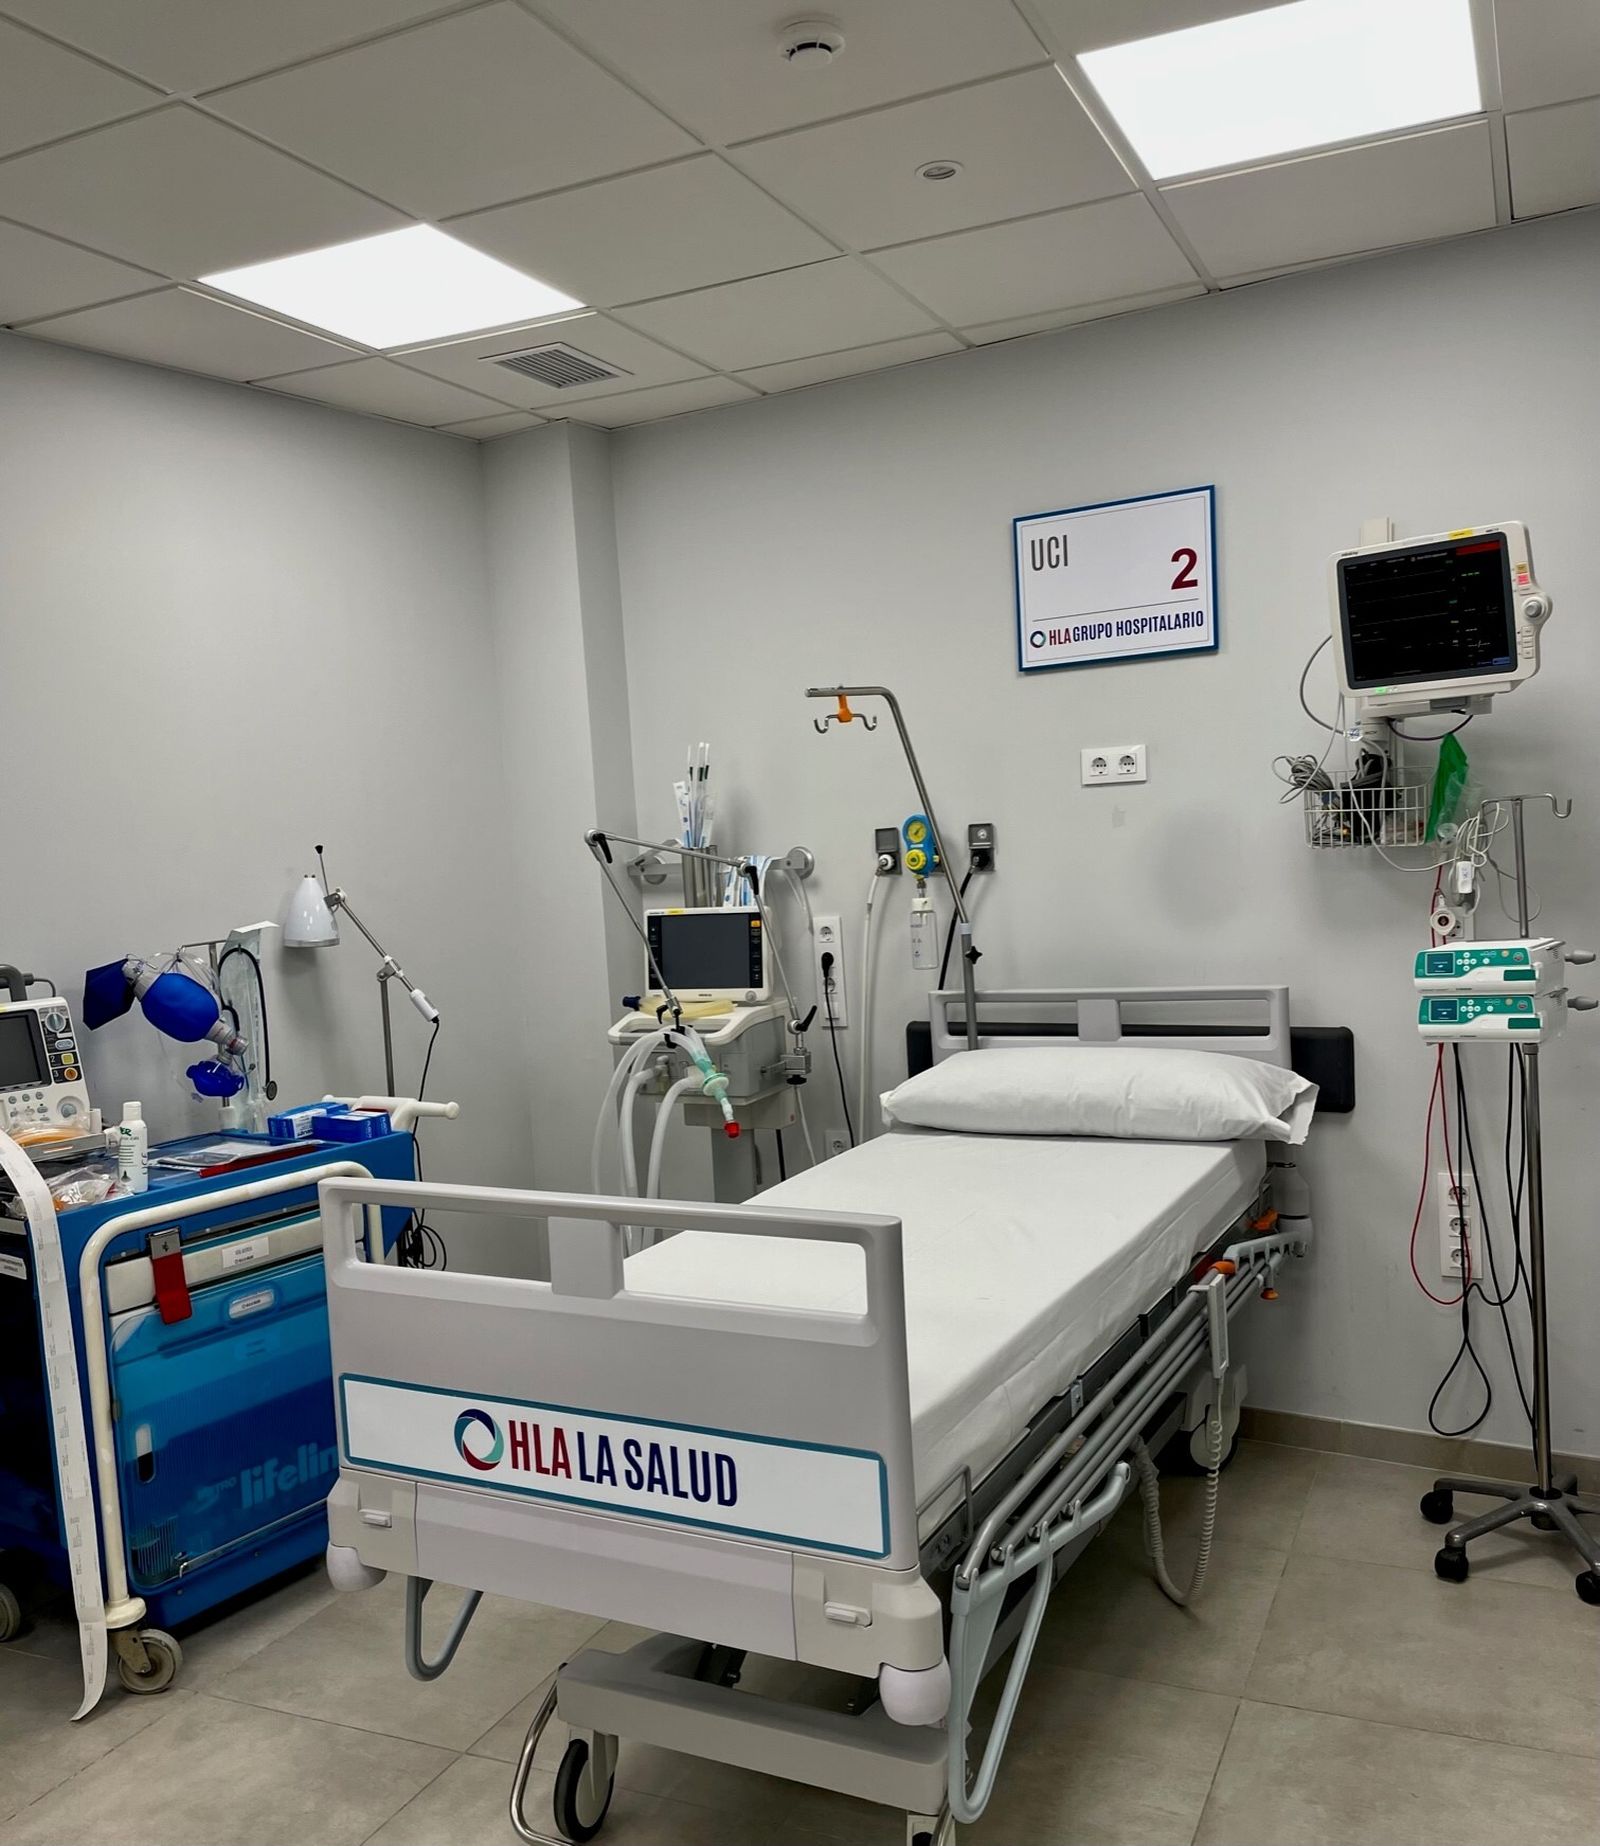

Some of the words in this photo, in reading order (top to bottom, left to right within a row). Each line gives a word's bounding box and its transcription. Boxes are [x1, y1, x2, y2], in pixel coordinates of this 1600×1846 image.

[1030, 534, 1069, 572] UCI
[1170, 547, 1199, 590] 2
[1048, 627, 1072, 646] HLA
[1072, 622, 1113, 643] GRUPO
[1116, 610, 1204, 636] HOSPITALARIO
[508, 1419, 572, 1480] HLA
[576, 1430, 619, 1487] LA
[623, 1437, 738, 1507] SALUD
